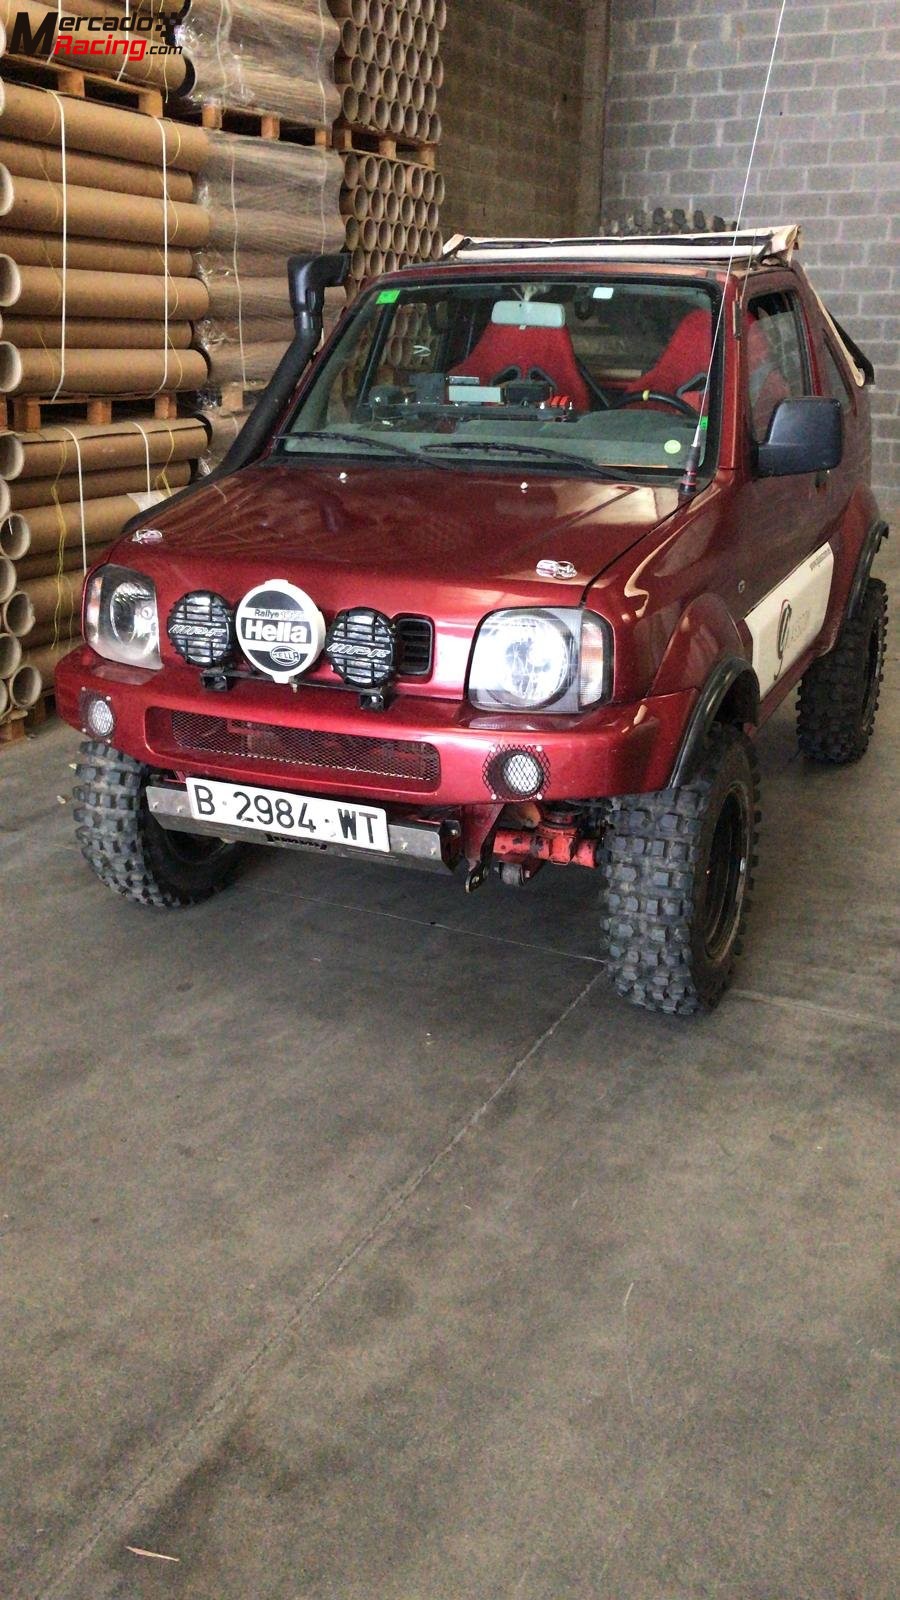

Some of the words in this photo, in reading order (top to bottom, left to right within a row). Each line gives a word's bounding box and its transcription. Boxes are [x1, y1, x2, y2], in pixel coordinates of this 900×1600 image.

[255, 608, 280, 619] Rallye
[245, 619, 308, 643] Hella
[272, 651, 300, 661] HELLA
[194, 784, 216, 815] B
[232, 791, 316, 833] 2984
[337, 808, 378, 844] WT
